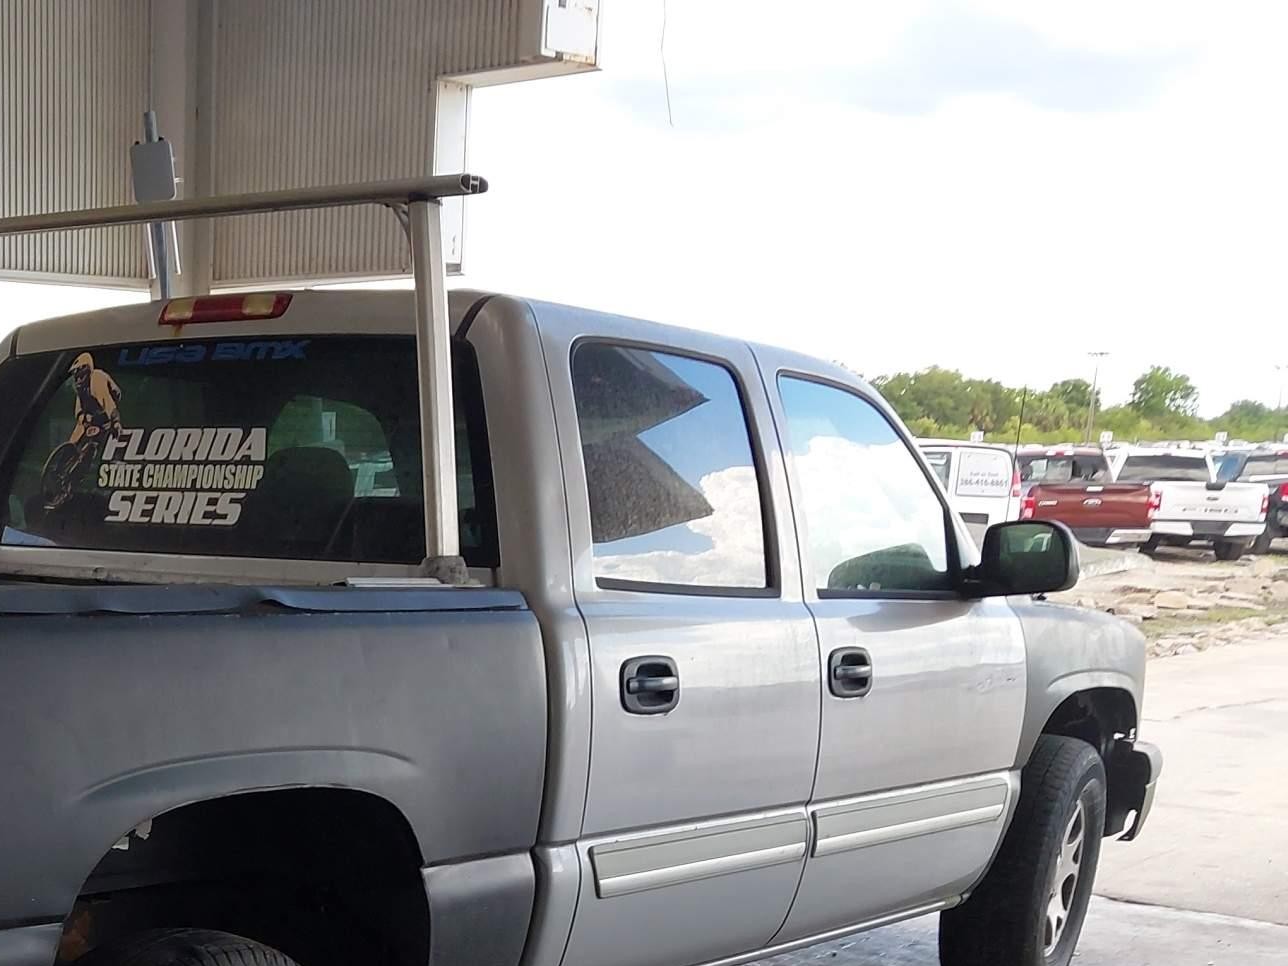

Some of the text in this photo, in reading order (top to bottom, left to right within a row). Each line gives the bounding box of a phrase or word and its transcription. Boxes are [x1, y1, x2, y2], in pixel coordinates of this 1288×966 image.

[102, 427, 267, 461] FLORIDA
[98, 464, 264, 489] STATE CHAMPIONSHIP
[104, 490, 247, 526] SERIES
